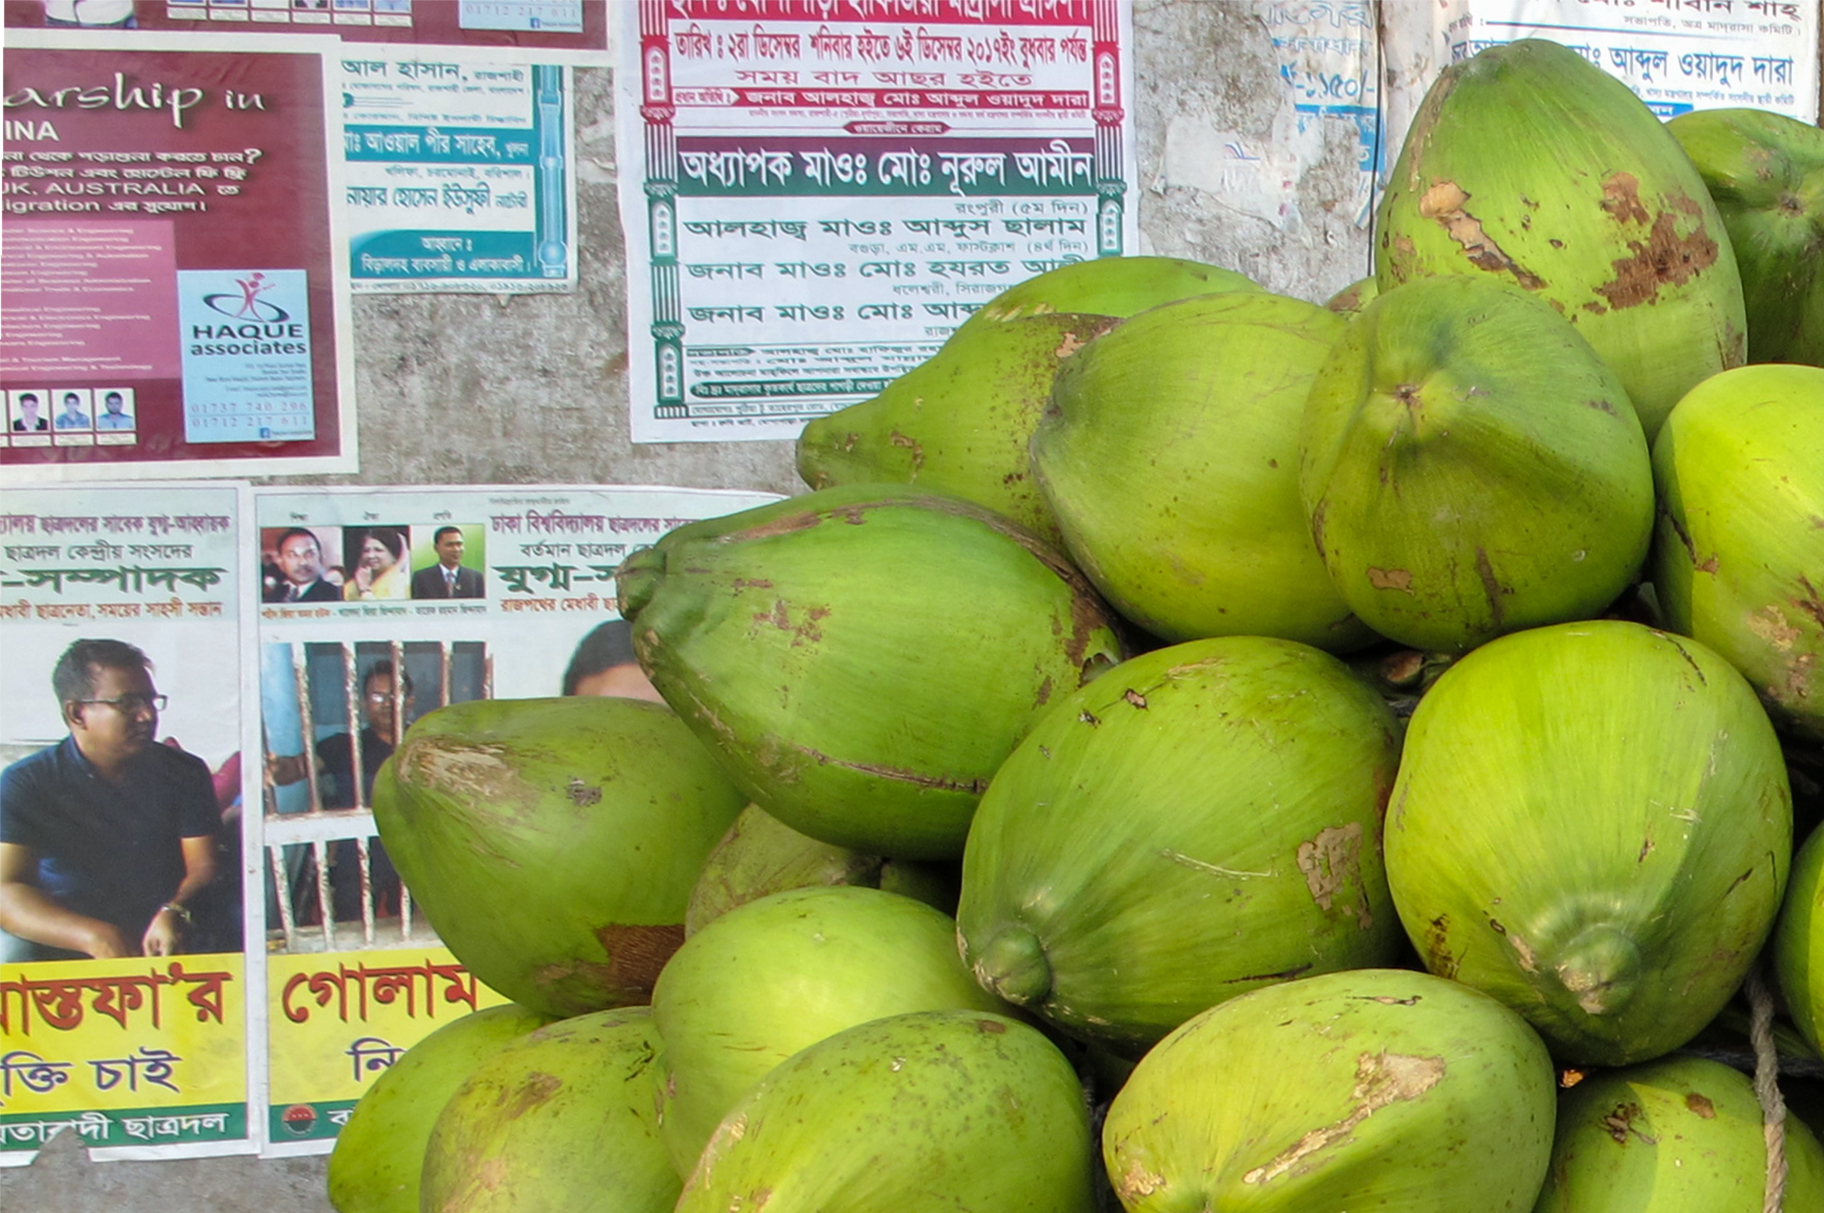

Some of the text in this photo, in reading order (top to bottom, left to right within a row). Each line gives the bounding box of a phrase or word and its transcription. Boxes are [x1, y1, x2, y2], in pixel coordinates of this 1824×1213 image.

[519, 7, 543, 18] 217
[674, 22, 712, 60] তারিখ
[728, 31, 749, 61] ২রা
[753, 22, 801, 60] ডিসেম্বর
[809, 23, 852, 60] শনিবার
[855, 27, 891, 65] হইতে
[916, 26, 963, 62] ডিসেম্বর
[1018, 35, 1056, 69] বুধবার
[341, 60, 387, 77] আল
[1608, 46, 1794, 88] আব্দুল ওয়াদুদ দারা
[735, 69, 1033, 88] সময় বাদ আছর হইতে
[225, 89, 266, 111] in
[743, 91, 798, 106] জনাব
[801, 92, 876, 108] আলহাজ্ব
[882, 91, 921, 106] মোঃ
[925, 92, 980, 109] আব্দুল
[1051, 93, 1089, 108] দারা
[425, 126, 450, 154] পীর
[156, 151, 208, 164] করতে
[79, 168, 119, 180] এবং
[679, 139, 1094, 197] অধ্যাপক মাওঃ মোঃ নূরুল আমীন
[45, 183, 206, 196] AUSTRALIA
[682, 216, 1088, 242] আলহাজ্ব মাওঃ আব্দুস ছালাম
[684, 263, 765, 280] জনাব
[773, 261, 847, 279] মাওঃ
[858, 261, 916, 279] মোঃ
[925, 261, 1011, 278] হযরত
[686, 302, 914, 323] জনাব মাওঃ মোঃ
[192, 323, 305, 341] HAQUE
[191, 341, 308, 356] associates
[40, 515, 100, 535] ছাত্রদলের
[103, 515, 145, 534] সাবেক
[490, 509, 664, 535] ঢাকা বিশ্ববিদ্যালয় ছাত্রদলের
[4, 539, 193, 562] ছাত্রদল কেন্দ্রীয় সংসদের
[520, 540, 627, 558] বর্তমান ছাত্রদল
[97, 602, 141, 618] সময়ের
[145, 597, 182, 619] সাহসী
[187, 602, 223, 617] সন্তান
[561, 592, 599, 612] মেধাবী
[282, 957, 479, 1025] গোলাম
[87, 1045, 184, 1093] চাই
[121, 1112, 230, 1142] ছাত্রদল
